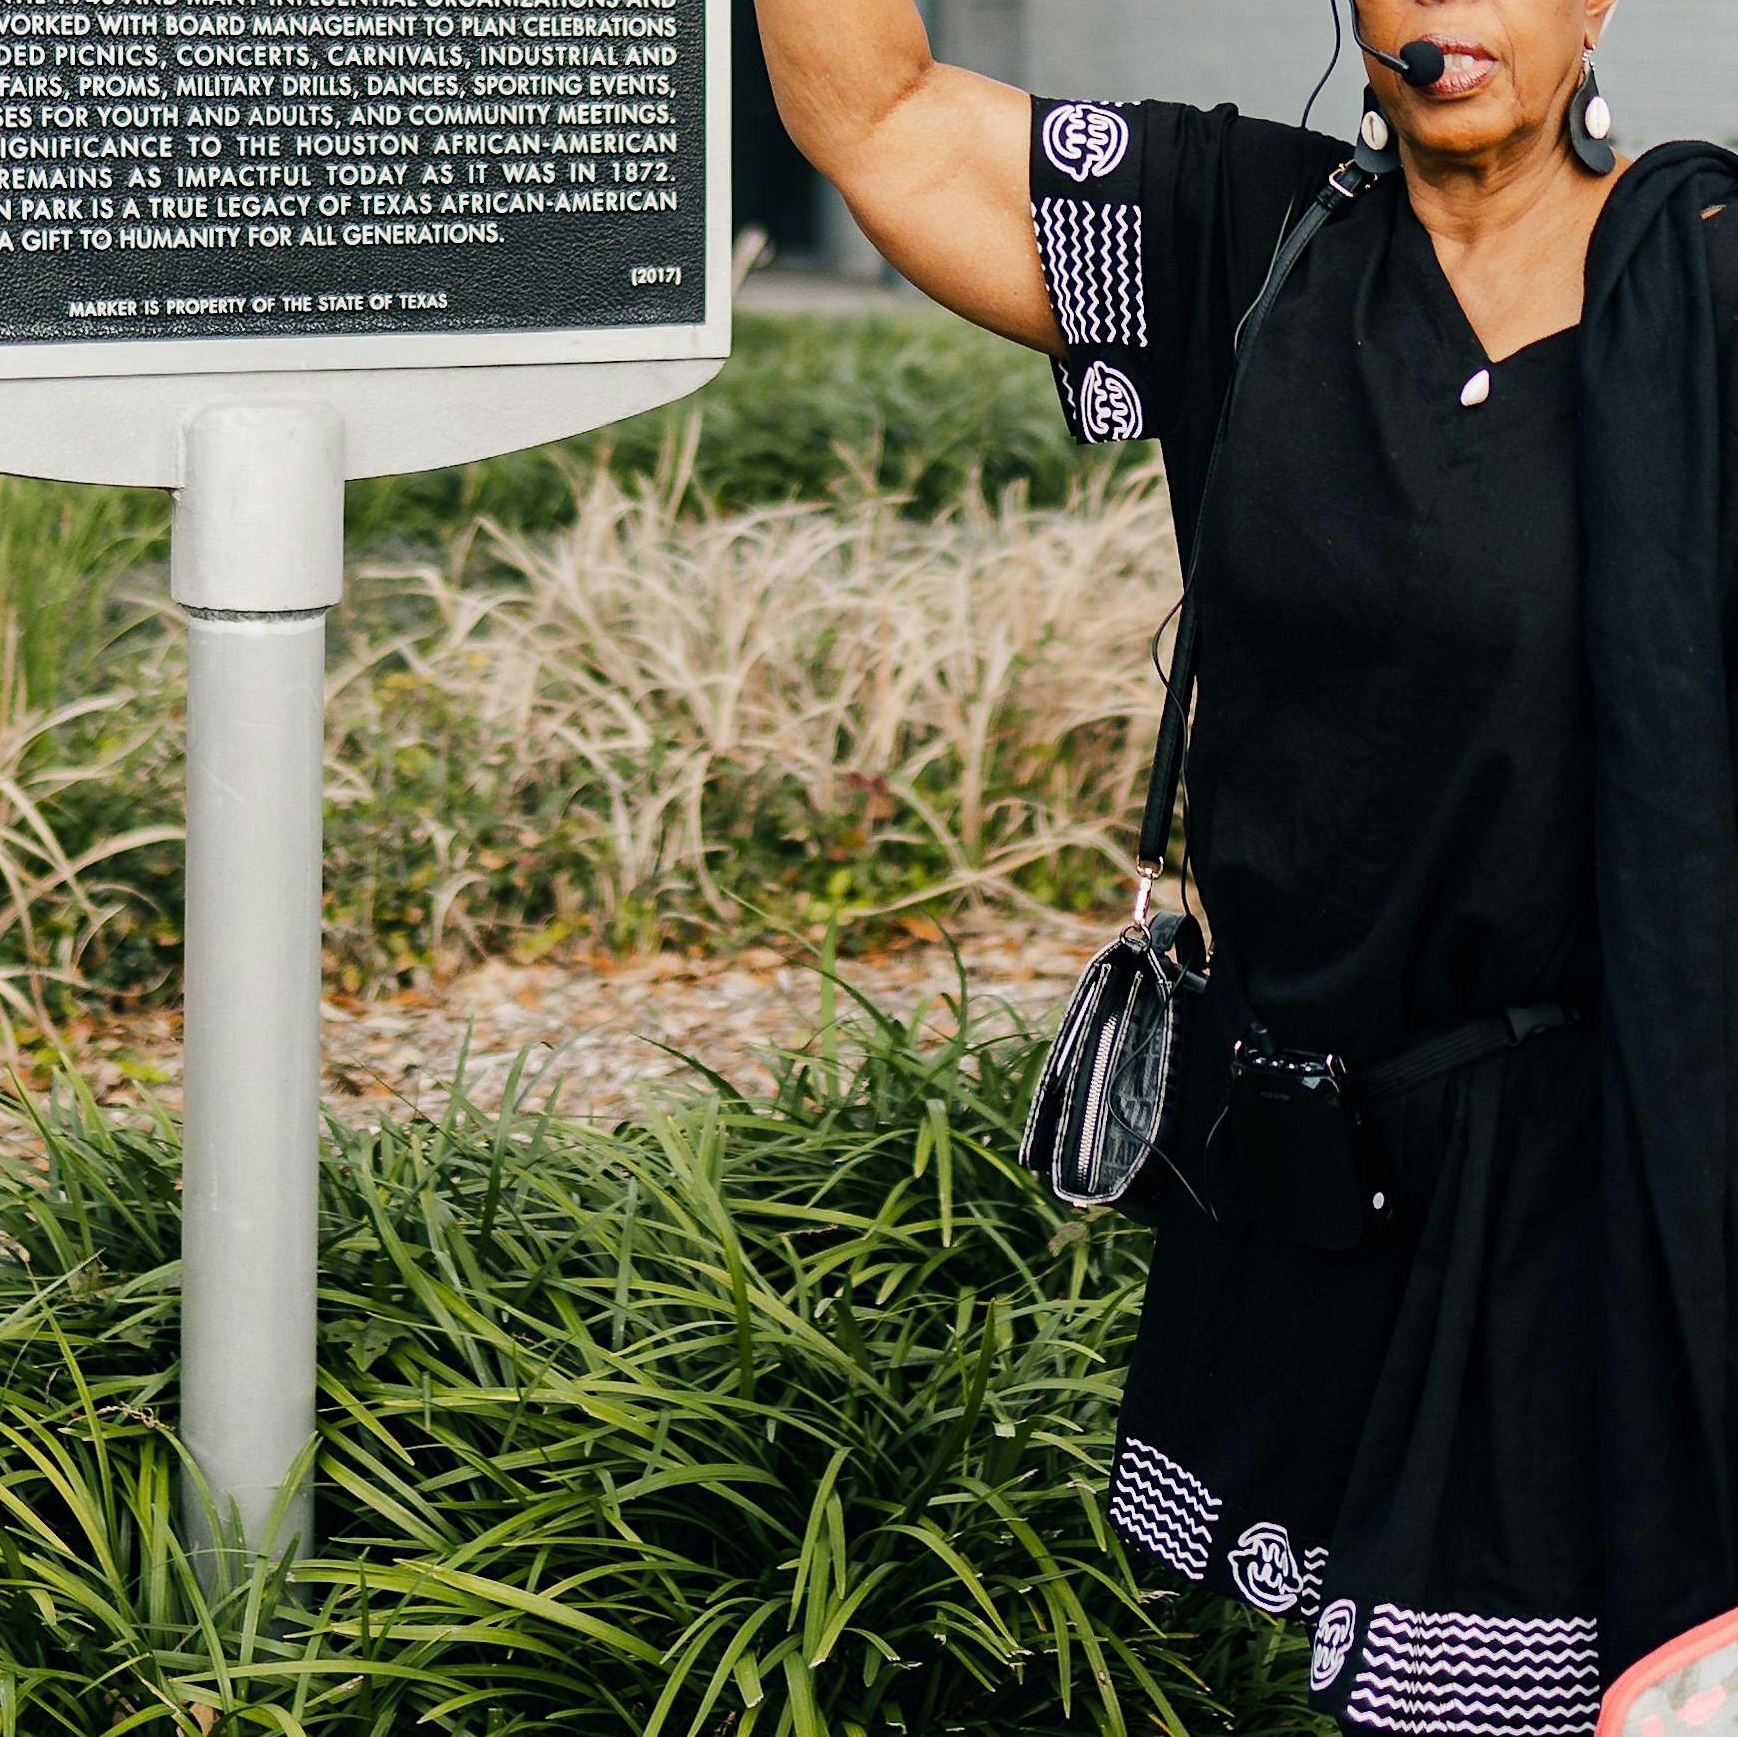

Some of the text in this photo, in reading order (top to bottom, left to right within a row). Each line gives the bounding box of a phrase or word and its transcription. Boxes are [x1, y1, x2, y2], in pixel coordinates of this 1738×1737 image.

[97, 14, 158, 36] WITH
[165, 14, 245, 36] BOARD
[252, 15, 417, 36] MANAGEMENT
[423, 15, 454, 37] TO
[462, 16, 516, 37] PLAN
[523, 16, 677, 37] CELEBRATIONS
[0, 74, 70, 100] FAIRS,
[79, 74, 167, 100] PROMS,
[176, 74, 275, 97] MILITARY
[283, 75, 359, 100] DRILLS,
[368, 74, 466, 99] DANCES,
[473, 75, 583, 96] SPORTING
[589, 74, 676, 98] EVENTS,
[187, 135, 222, 158] TO
[236, 136, 280, 156] THE
[296, 134, 418, 156] HOUSTON
[433, 132, 677, 155] AFRICAN-AMERICAN
[21, 197, 84, 221] PARK
[92, 197, 114, 220] IS
[122, 197, 141, 219] A
[148, 196, 208, 219] TRUE
[217, 195, 311, 218] LEGACY
[319, 195, 352, 217] OF
[359, 193, 433, 215] TEXAS
[441, 191, 677, 214] AFRICAN-AMERICAN
[631, 266, 683, 286] (2017)
[68, 293, 448, 319] MARKER IS PROPERTY OF THE STATE OF TEXAS
